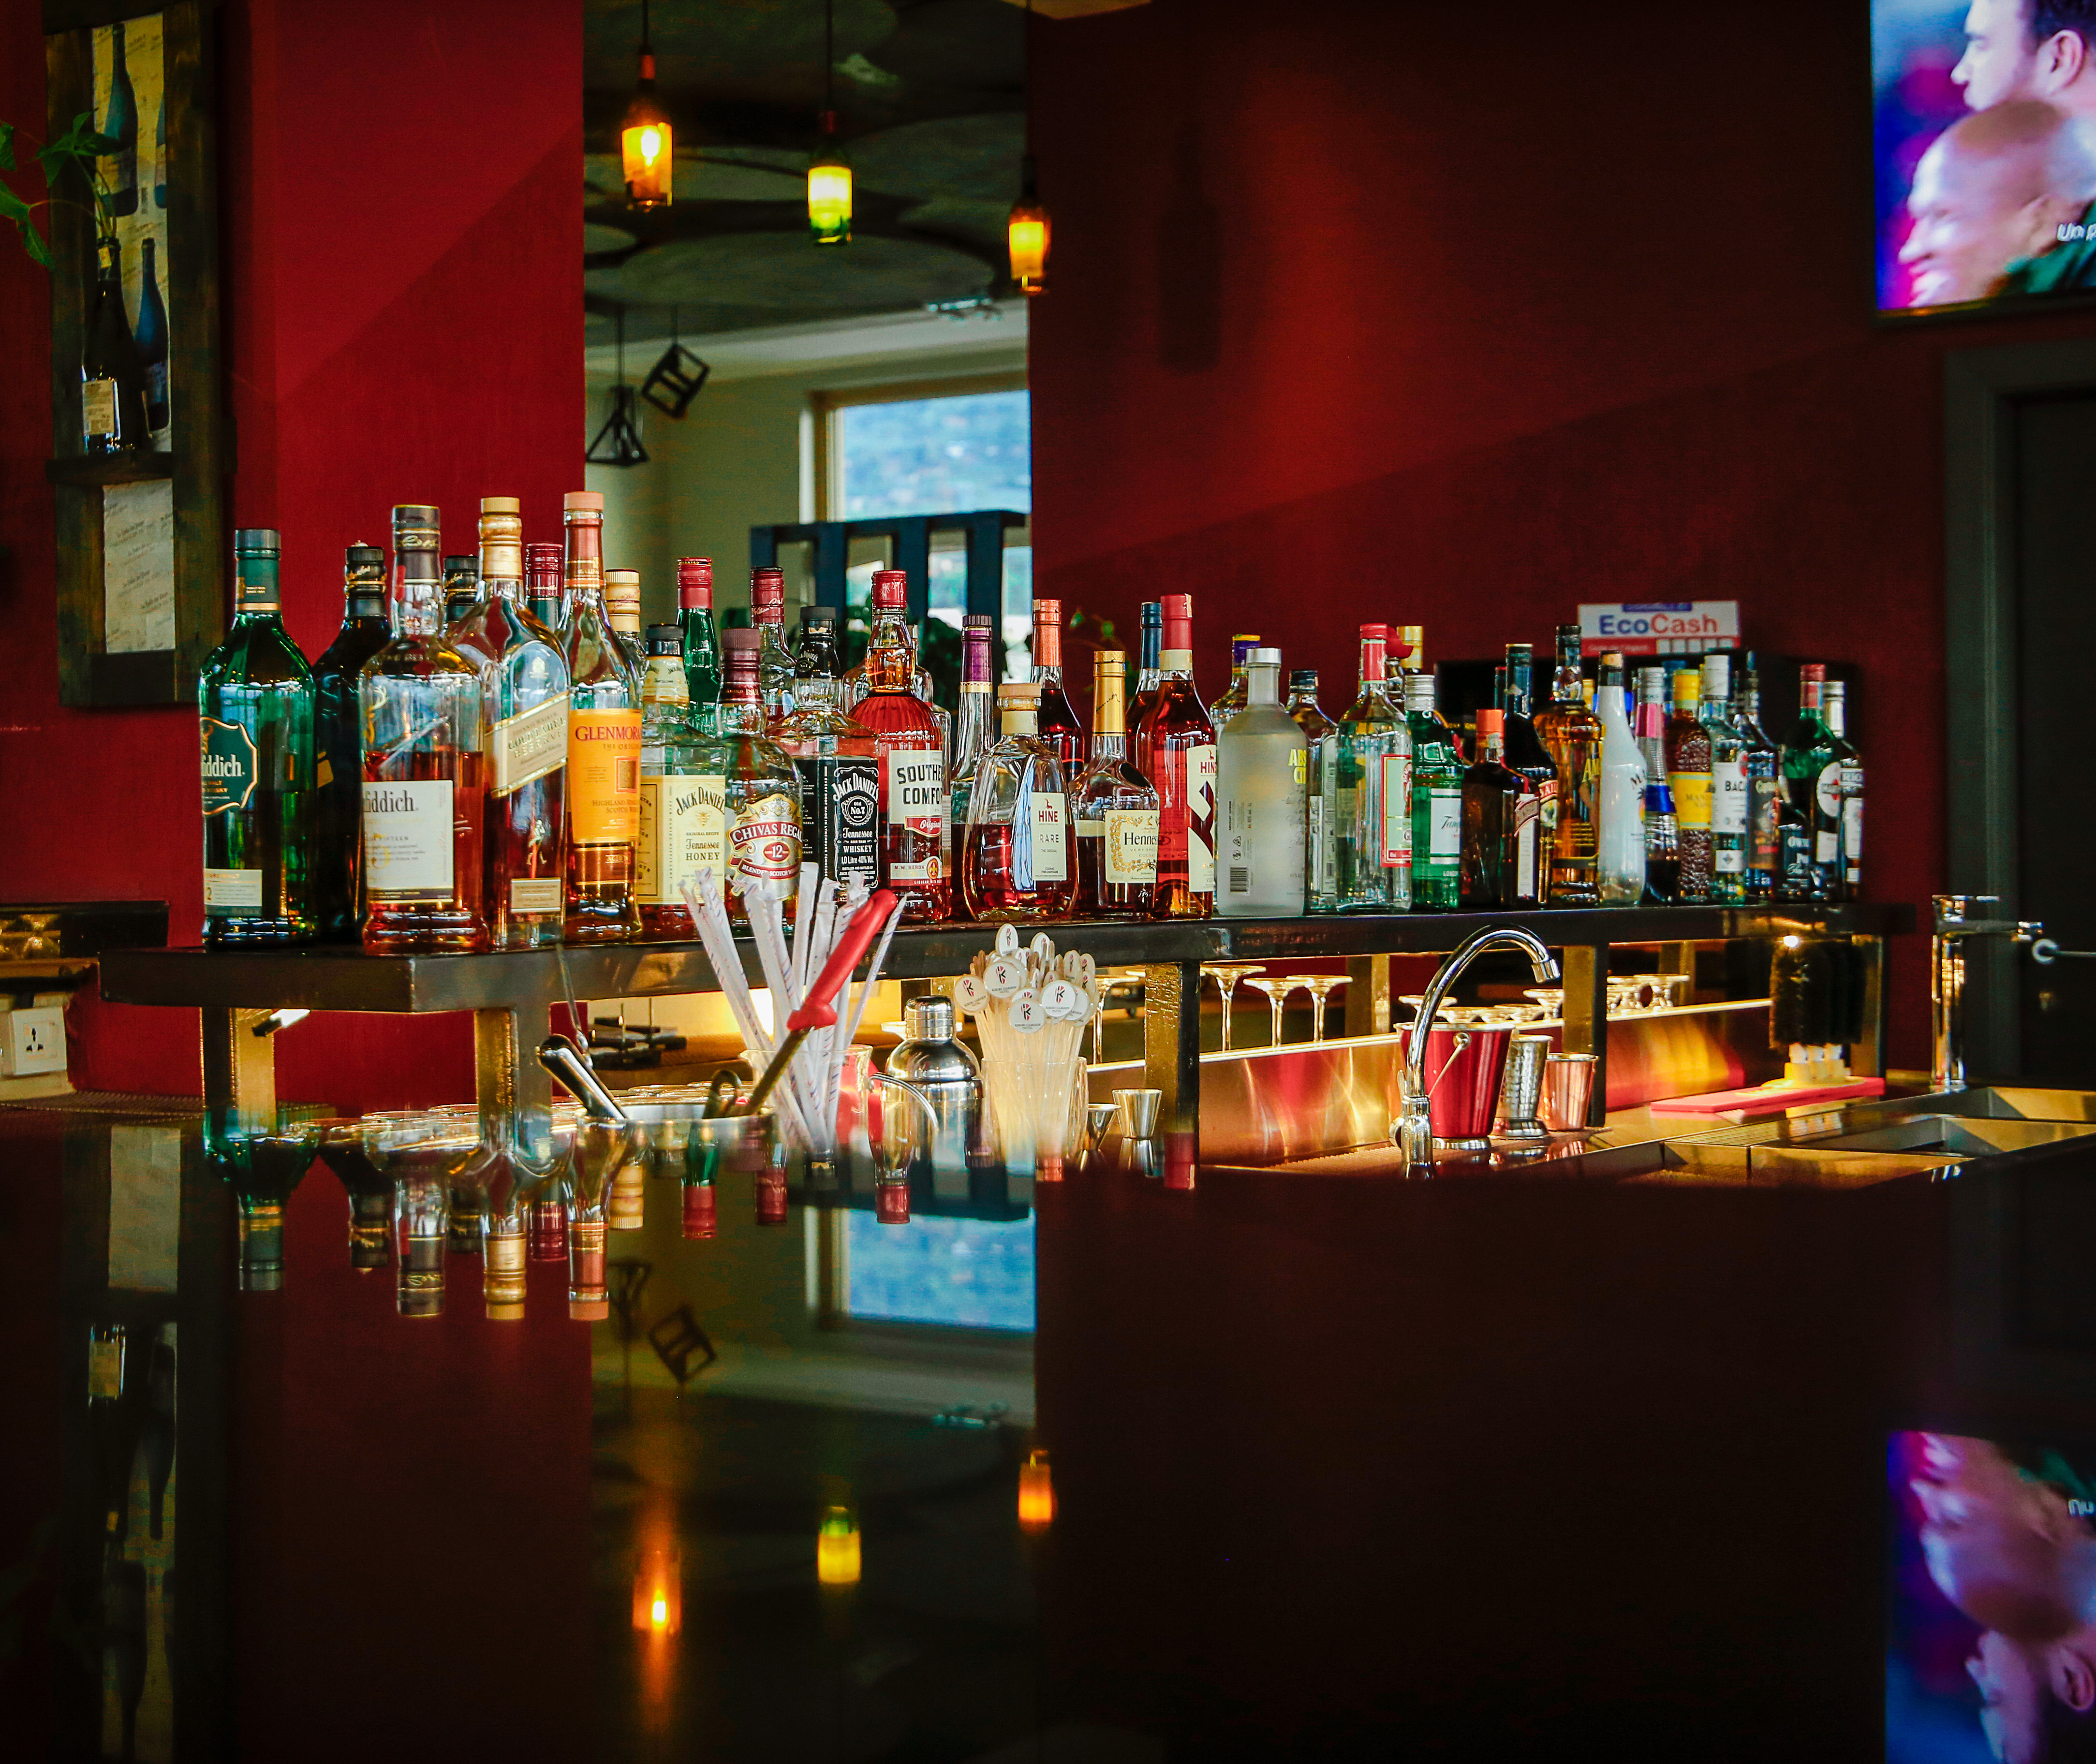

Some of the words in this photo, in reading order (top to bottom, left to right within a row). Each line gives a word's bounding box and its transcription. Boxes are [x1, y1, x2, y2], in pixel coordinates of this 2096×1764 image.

[1599, 613, 1718, 635] EcoCash
[831, 777, 853, 802] JACK
[675, 791, 699, 816] JACK
[850, 807, 865, 815] No.7
[1038, 810, 1059, 823] HINE
[732, 823, 778, 843] CHIVAS
[780, 823, 803, 843] REGAL
[842, 827, 873, 838] Tennessee
[1039, 834, 1060, 843] RARE
[686, 838, 720, 850] Tennessee
[686, 852, 720, 861] HONEY
[771, 845, 783, 858] 12
